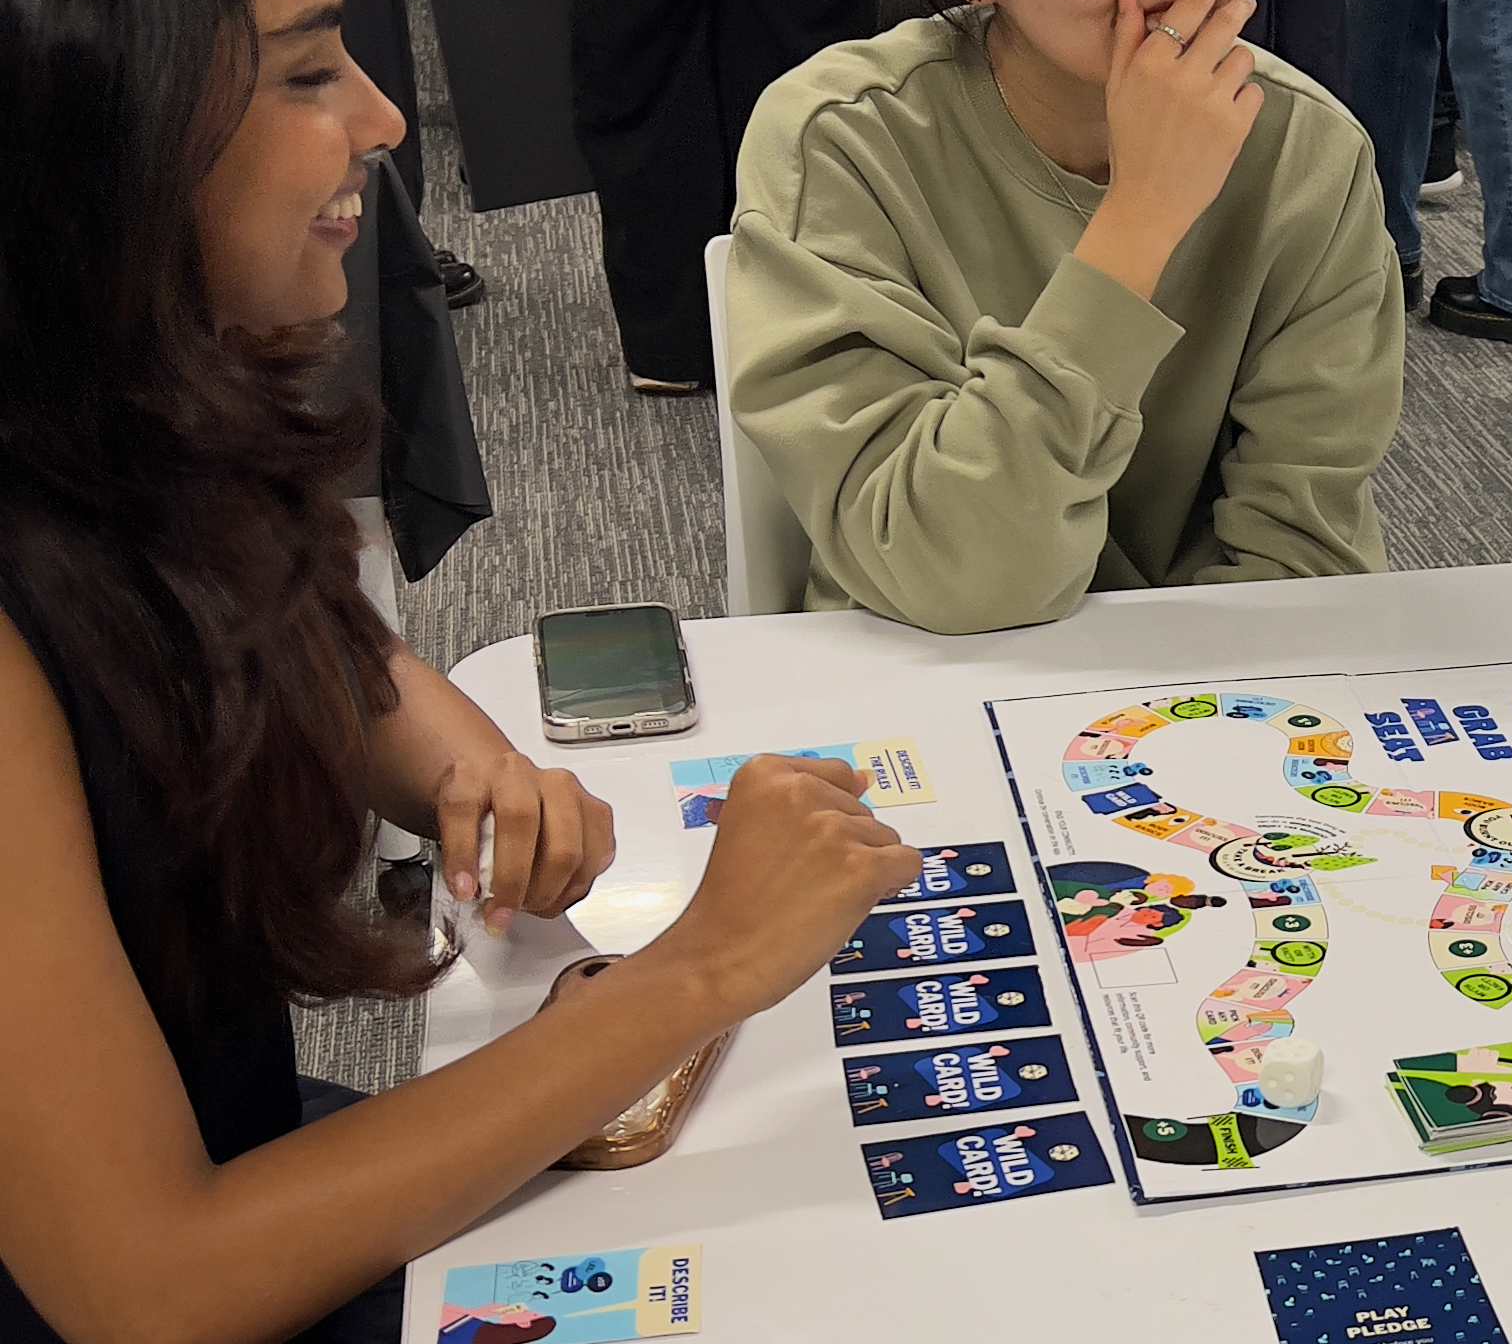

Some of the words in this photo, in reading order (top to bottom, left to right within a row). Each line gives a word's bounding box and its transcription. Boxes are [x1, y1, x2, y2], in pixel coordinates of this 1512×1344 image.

[869, 755, 882, 770] THE
[896, 750, 918, 783] DESCRIBE
[909, 778, 921, 790] IT
[923, 854, 951, 893] WILD
[1244, 865, 1285, 873] BREAK
[904, 913, 939, 962] CARD!
[937, 913, 969, 955] WILD
[915, 979, 950, 1033] CARD!
[948, 980, 982, 1026] WILD
[1205, 1010, 1217, 1025] CARD
[1229, 1010, 1239, 1022] PICK
[932, 1052, 971, 1110] CARD!
[967, 1053, 1004, 1102] WILD
[1157, 1121, 1175, 1136] +5
[1219, 1127, 1238, 1154] FINISH
[955, 1134, 1004, 1198] CARD!
[992, 1134, 1036, 1187] WILD
[648, 1285, 667, 1302] IT!
[670, 1257, 690, 1324] DESCRIBE
[1346, 1317, 1432, 1338] PLEDGE
[1355, 1305, 1410, 1323] PLAY
